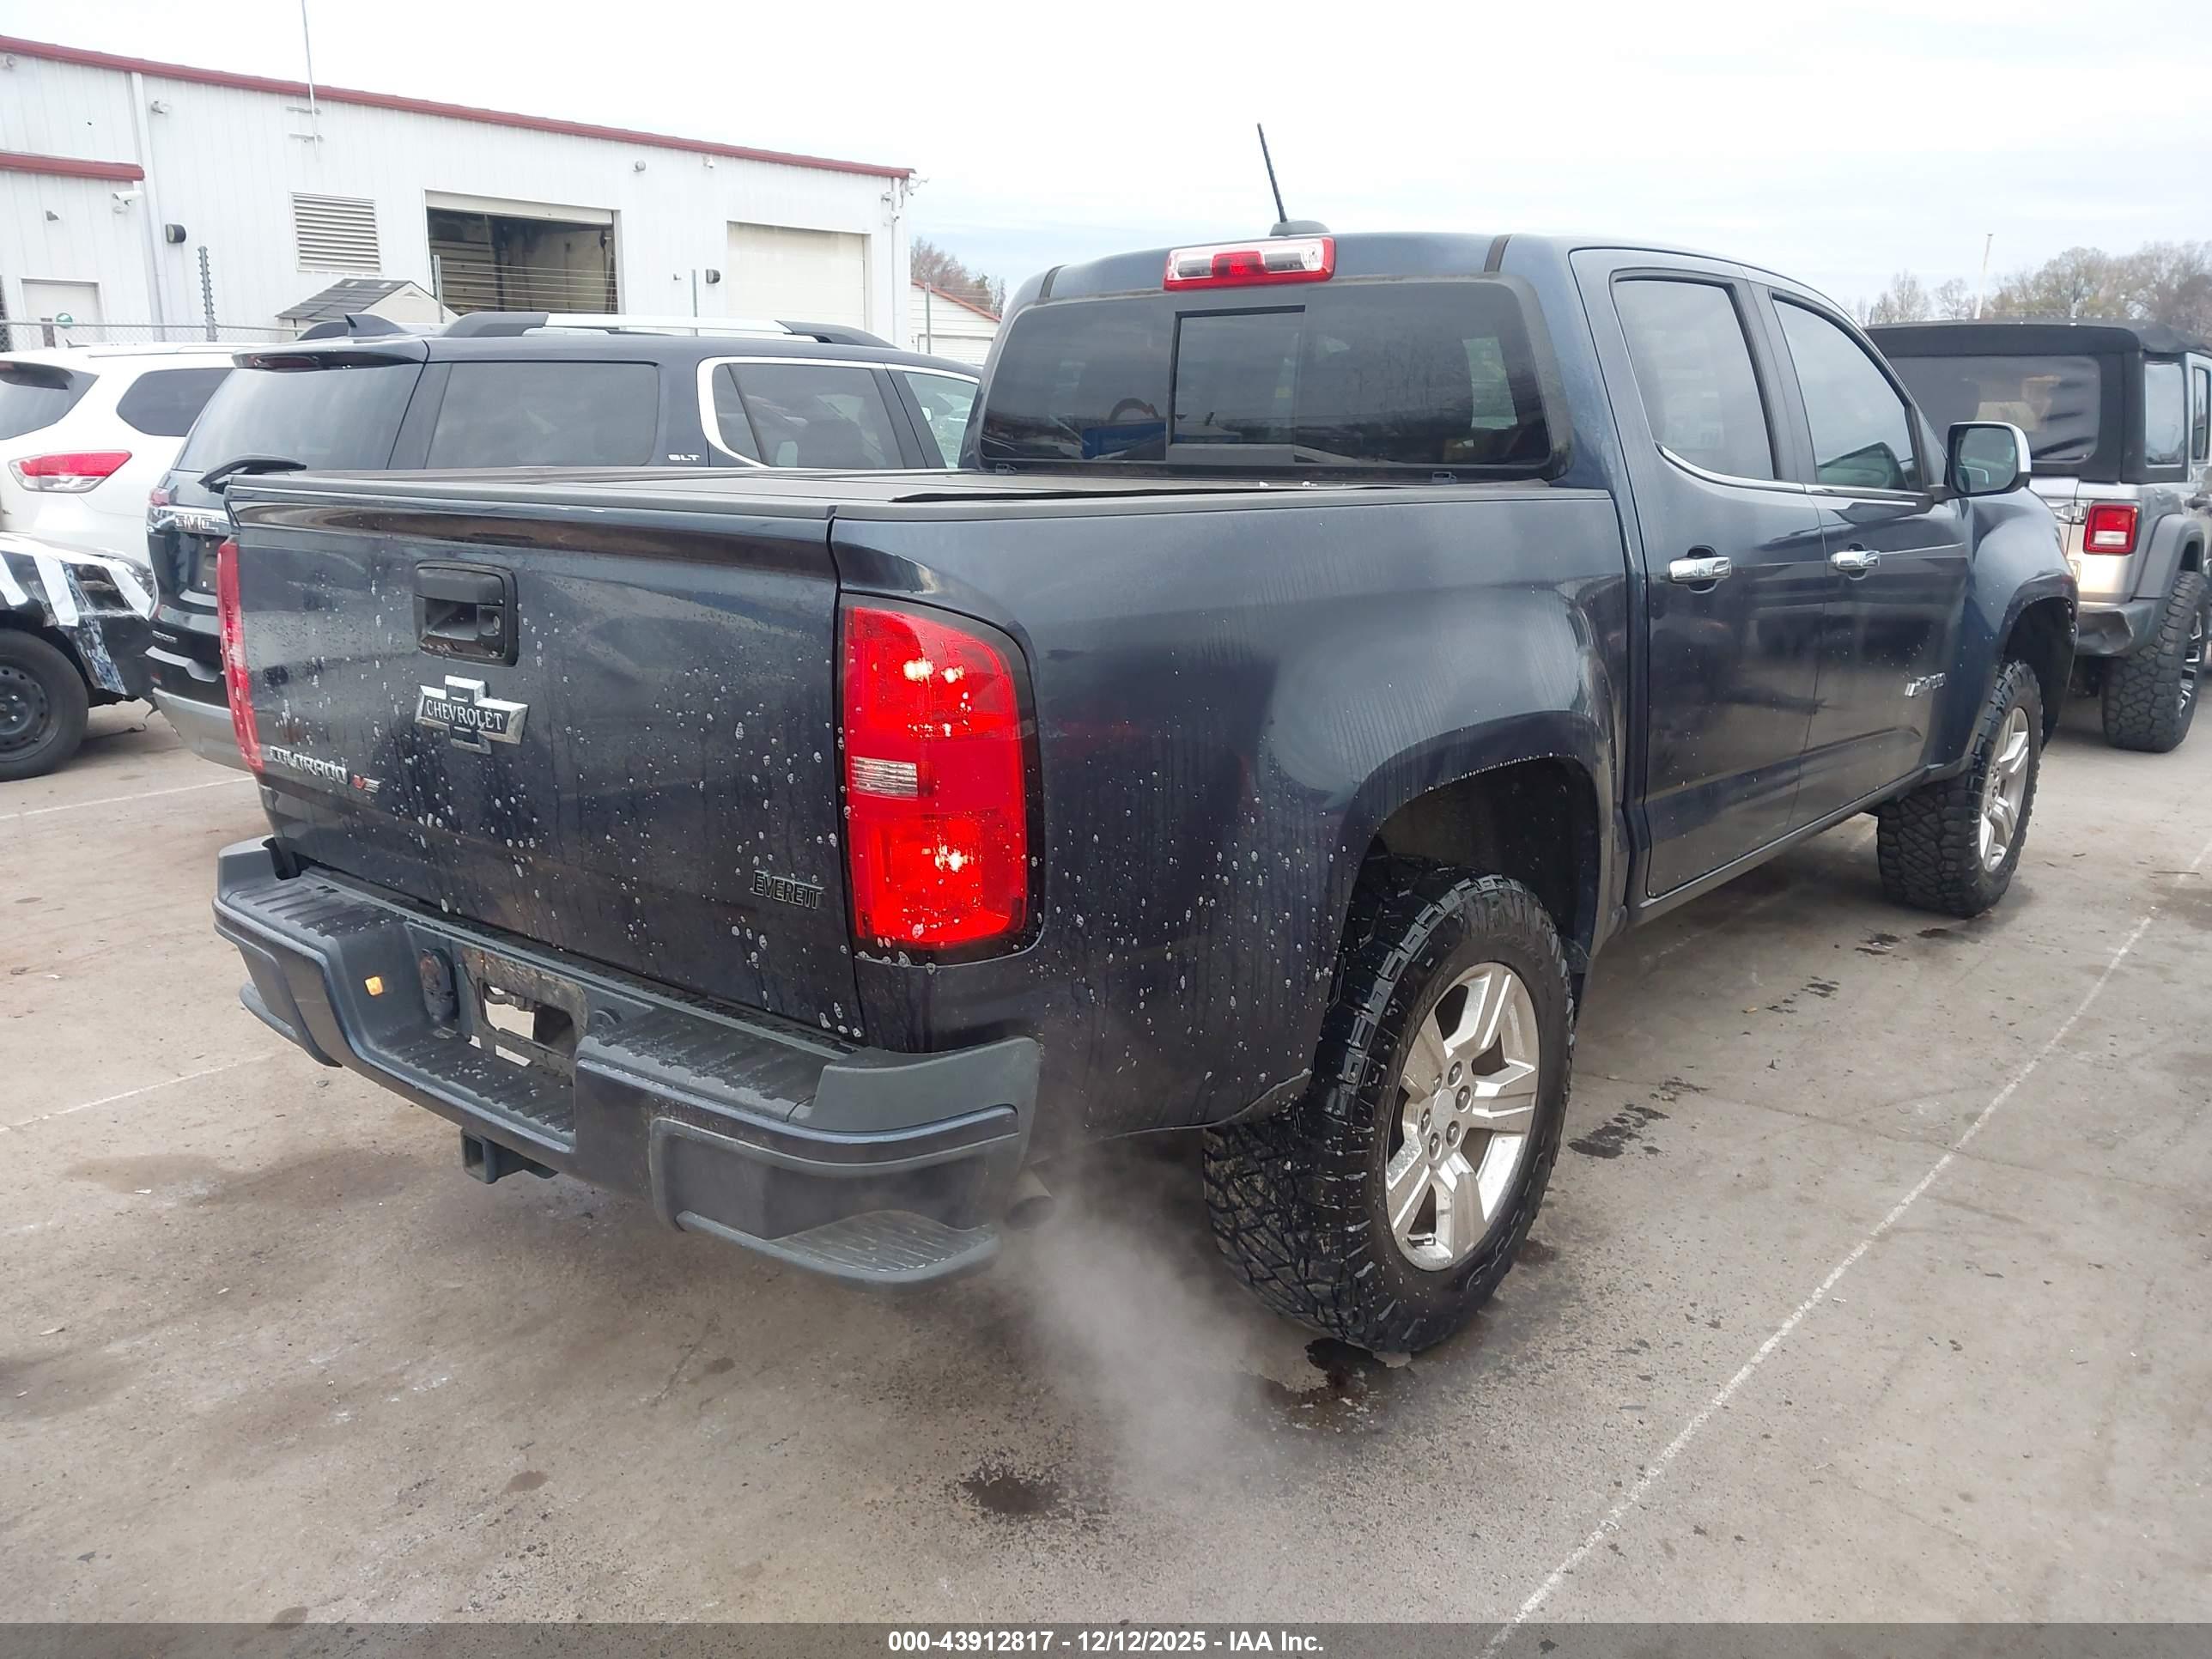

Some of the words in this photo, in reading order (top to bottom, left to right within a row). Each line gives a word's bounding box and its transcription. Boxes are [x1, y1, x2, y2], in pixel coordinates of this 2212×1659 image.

[175, 514, 220, 533] GMC
[425, 699, 503, 731] CHEVROLET
[751, 869, 825, 910] EVERETT
